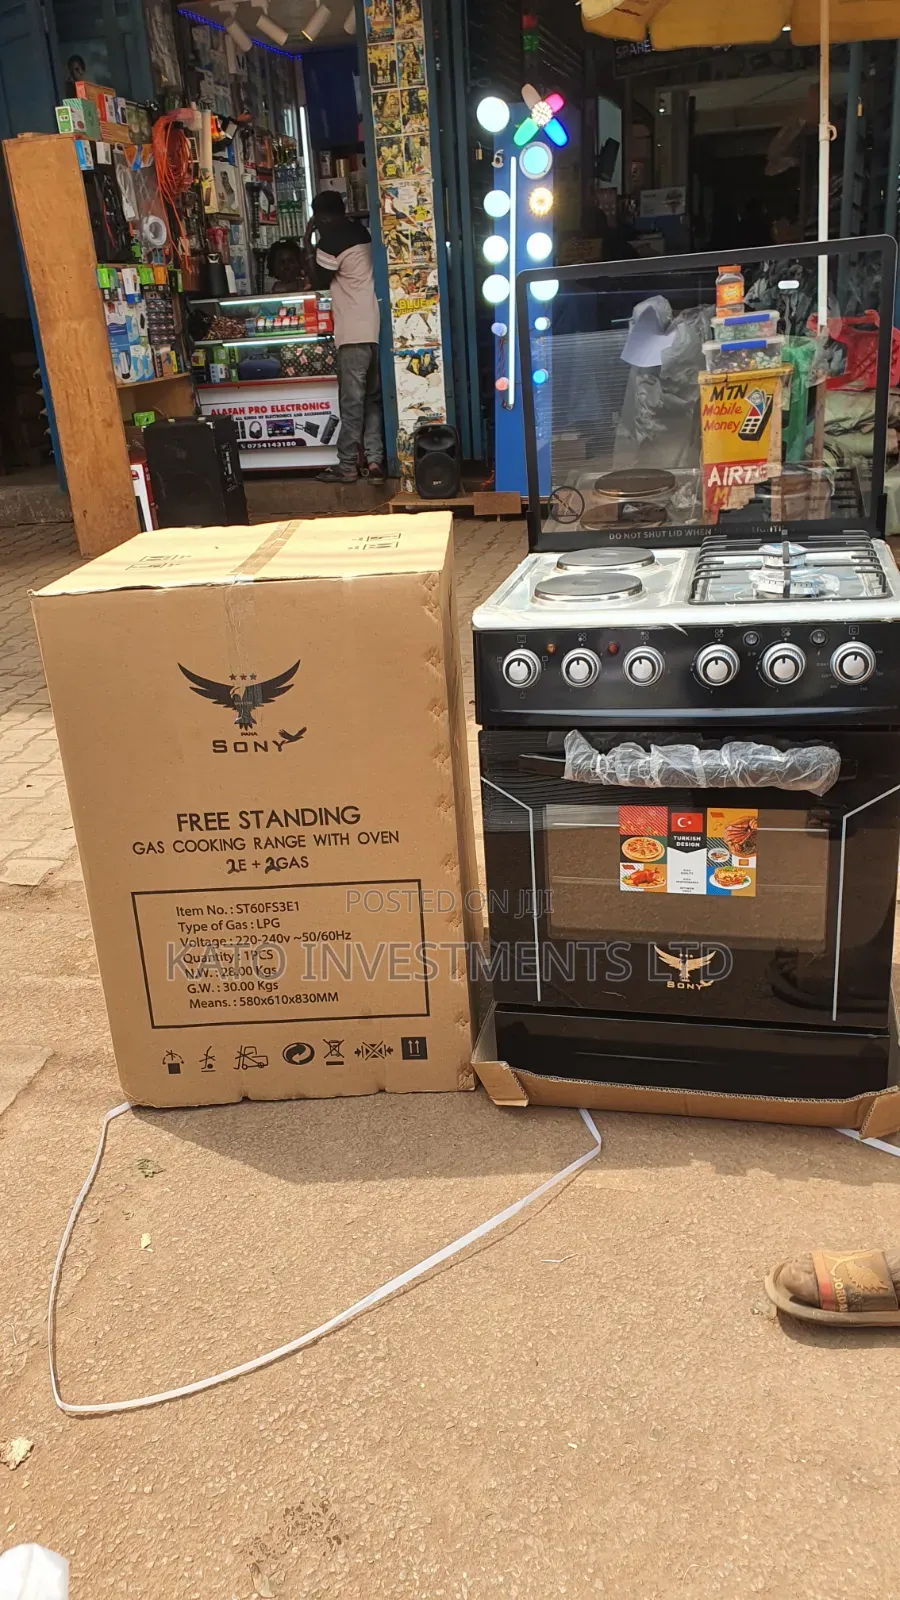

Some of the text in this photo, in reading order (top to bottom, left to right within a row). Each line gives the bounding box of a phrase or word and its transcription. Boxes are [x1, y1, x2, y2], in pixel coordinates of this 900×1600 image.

[710, 383, 749, 402] MTN
[248, 405, 268, 415] PRO
[270, 401, 331, 413] ELECTRONICS
[702, 402, 743, 417] Mobile
[704, 419, 740, 434] Money
[609, 533, 622, 541] DO
[623, 532, 641, 540] NOT
[643, 531, 666, 539] SHUT
[668, 530, 683, 538] LID
[684, 528, 712, 537] WHEN
[212, 740, 286, 754] SONY
[176, 805, 361, 833] FREE STANDING
[132, 830, 400, 855] GAS COOKING RANGE WITH OVEN
[176, 906, 204, 917] Item
[206, 904, 228, 915] No.
[236, 901, 299, 914] ST60FS3E1
[177, 921, 208, 934] Type
[210, 920, 224, 929] of
[225, 920, 248, 930] Gas
[256, 918, 281, 929] LPG
[180, 937, 227, 949] Voltage
[235, 934, 290, 946] 220-240v
[293, 930, 352, 942] ~50/60Hz
[183, 951, 234, 964] Quantity
[244, 950, 274, 960] 1PCS
[185, 967, 213, 979] N.W.
[221, 966, 253, 977] 28.00
[256, 965, 277, 978] Kgs
[187, 983, 215, 994] G.W.
[223, 981, 254, 992] 30.00
[257, 980, 279, 992] Kgs
[666, 980, 703, 991] SONY
[189, 998, 231, 1009] Means.
[239, 992, 339, 1007] 580x610x830MM
